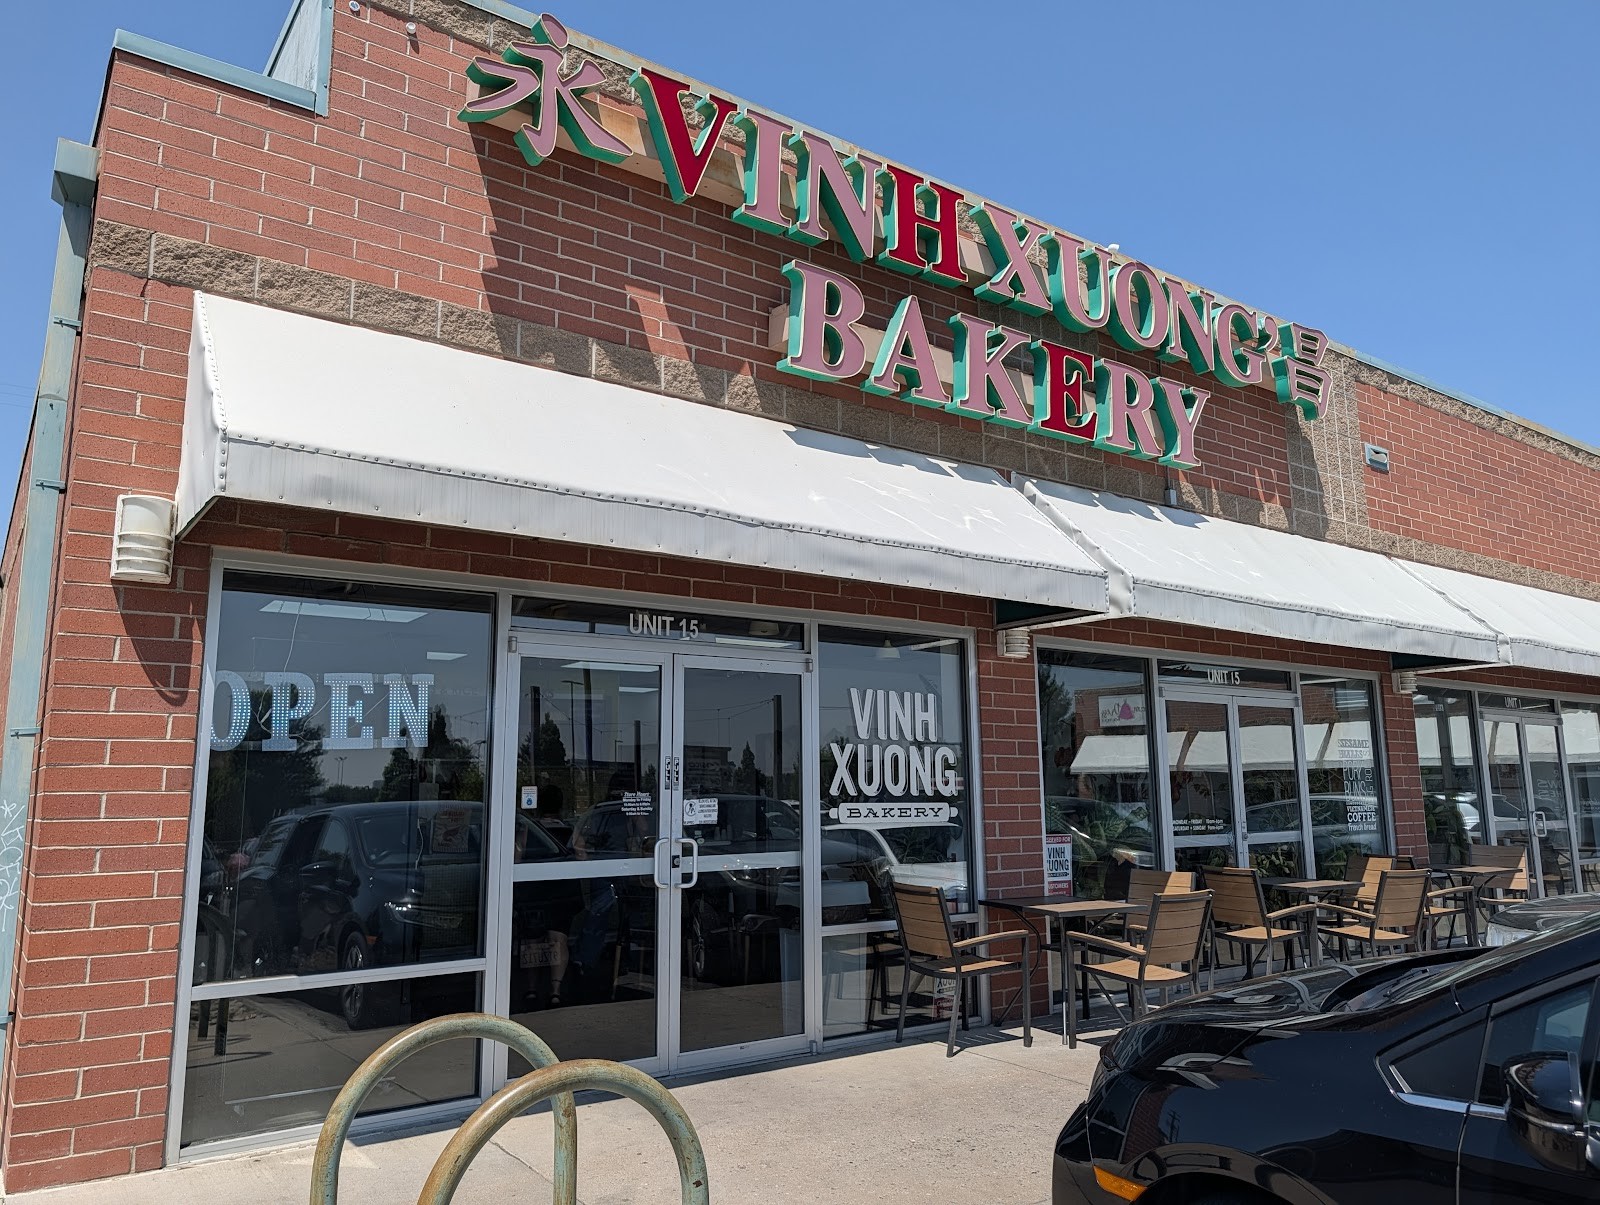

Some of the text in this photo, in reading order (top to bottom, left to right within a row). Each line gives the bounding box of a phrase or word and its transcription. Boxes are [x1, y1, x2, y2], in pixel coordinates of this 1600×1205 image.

[457, 13, 634, 167] 永
[629, 68, 969, 289] VINH
[776, 259, 1211, 470] BAKERY
[629, 613, 699, 639] UNIT 15
[1207, 668, 1241, 685] UNIT 15
[209, 670, 435, 751] OPEN
[849, 687, 939, 743] VINH
[829, 742, 959, 797] XUONG
[846, 807, 944, 819] BAKERY
[1347, 812, 1377, 822] COFFEE
[1047, 859, 1070, 872] UONG
